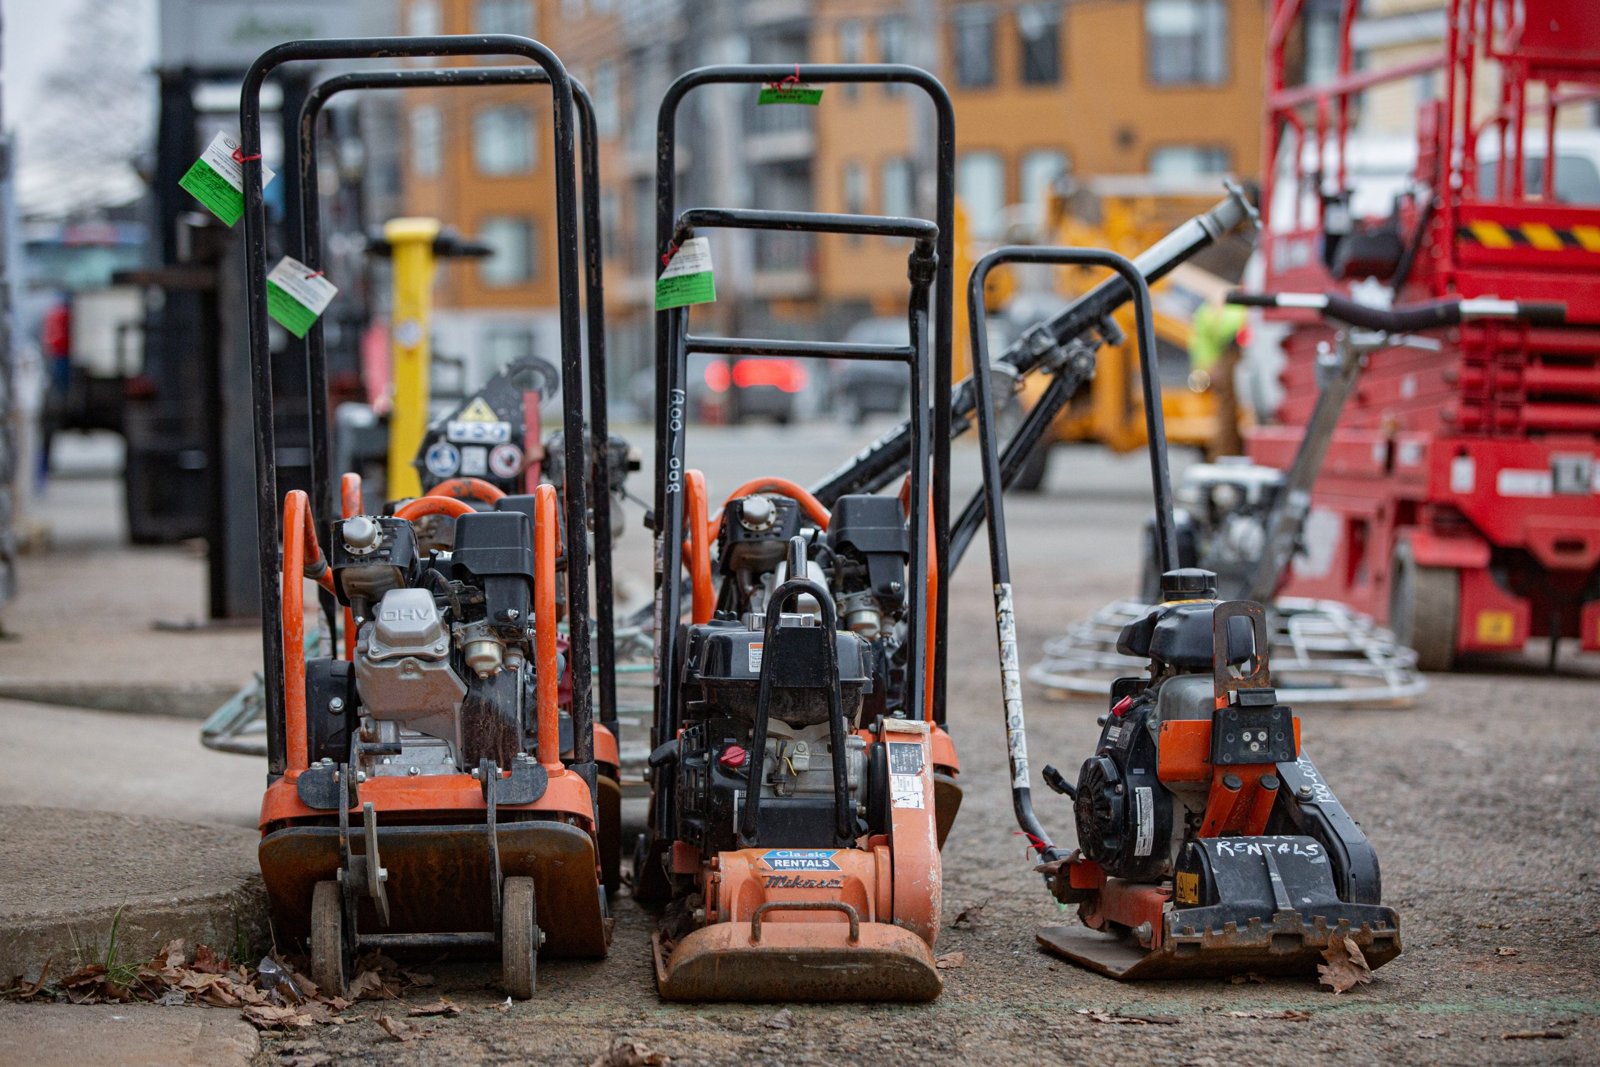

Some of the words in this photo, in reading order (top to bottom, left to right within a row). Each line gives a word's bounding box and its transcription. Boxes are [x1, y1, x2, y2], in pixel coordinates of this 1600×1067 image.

[666, 389, 685, 494] 1200-008
[380, 608, 431, 622] OHV
[1216, 840, 1319, 857] RENTALS
[774, 859, 830, 867] RENTALS
